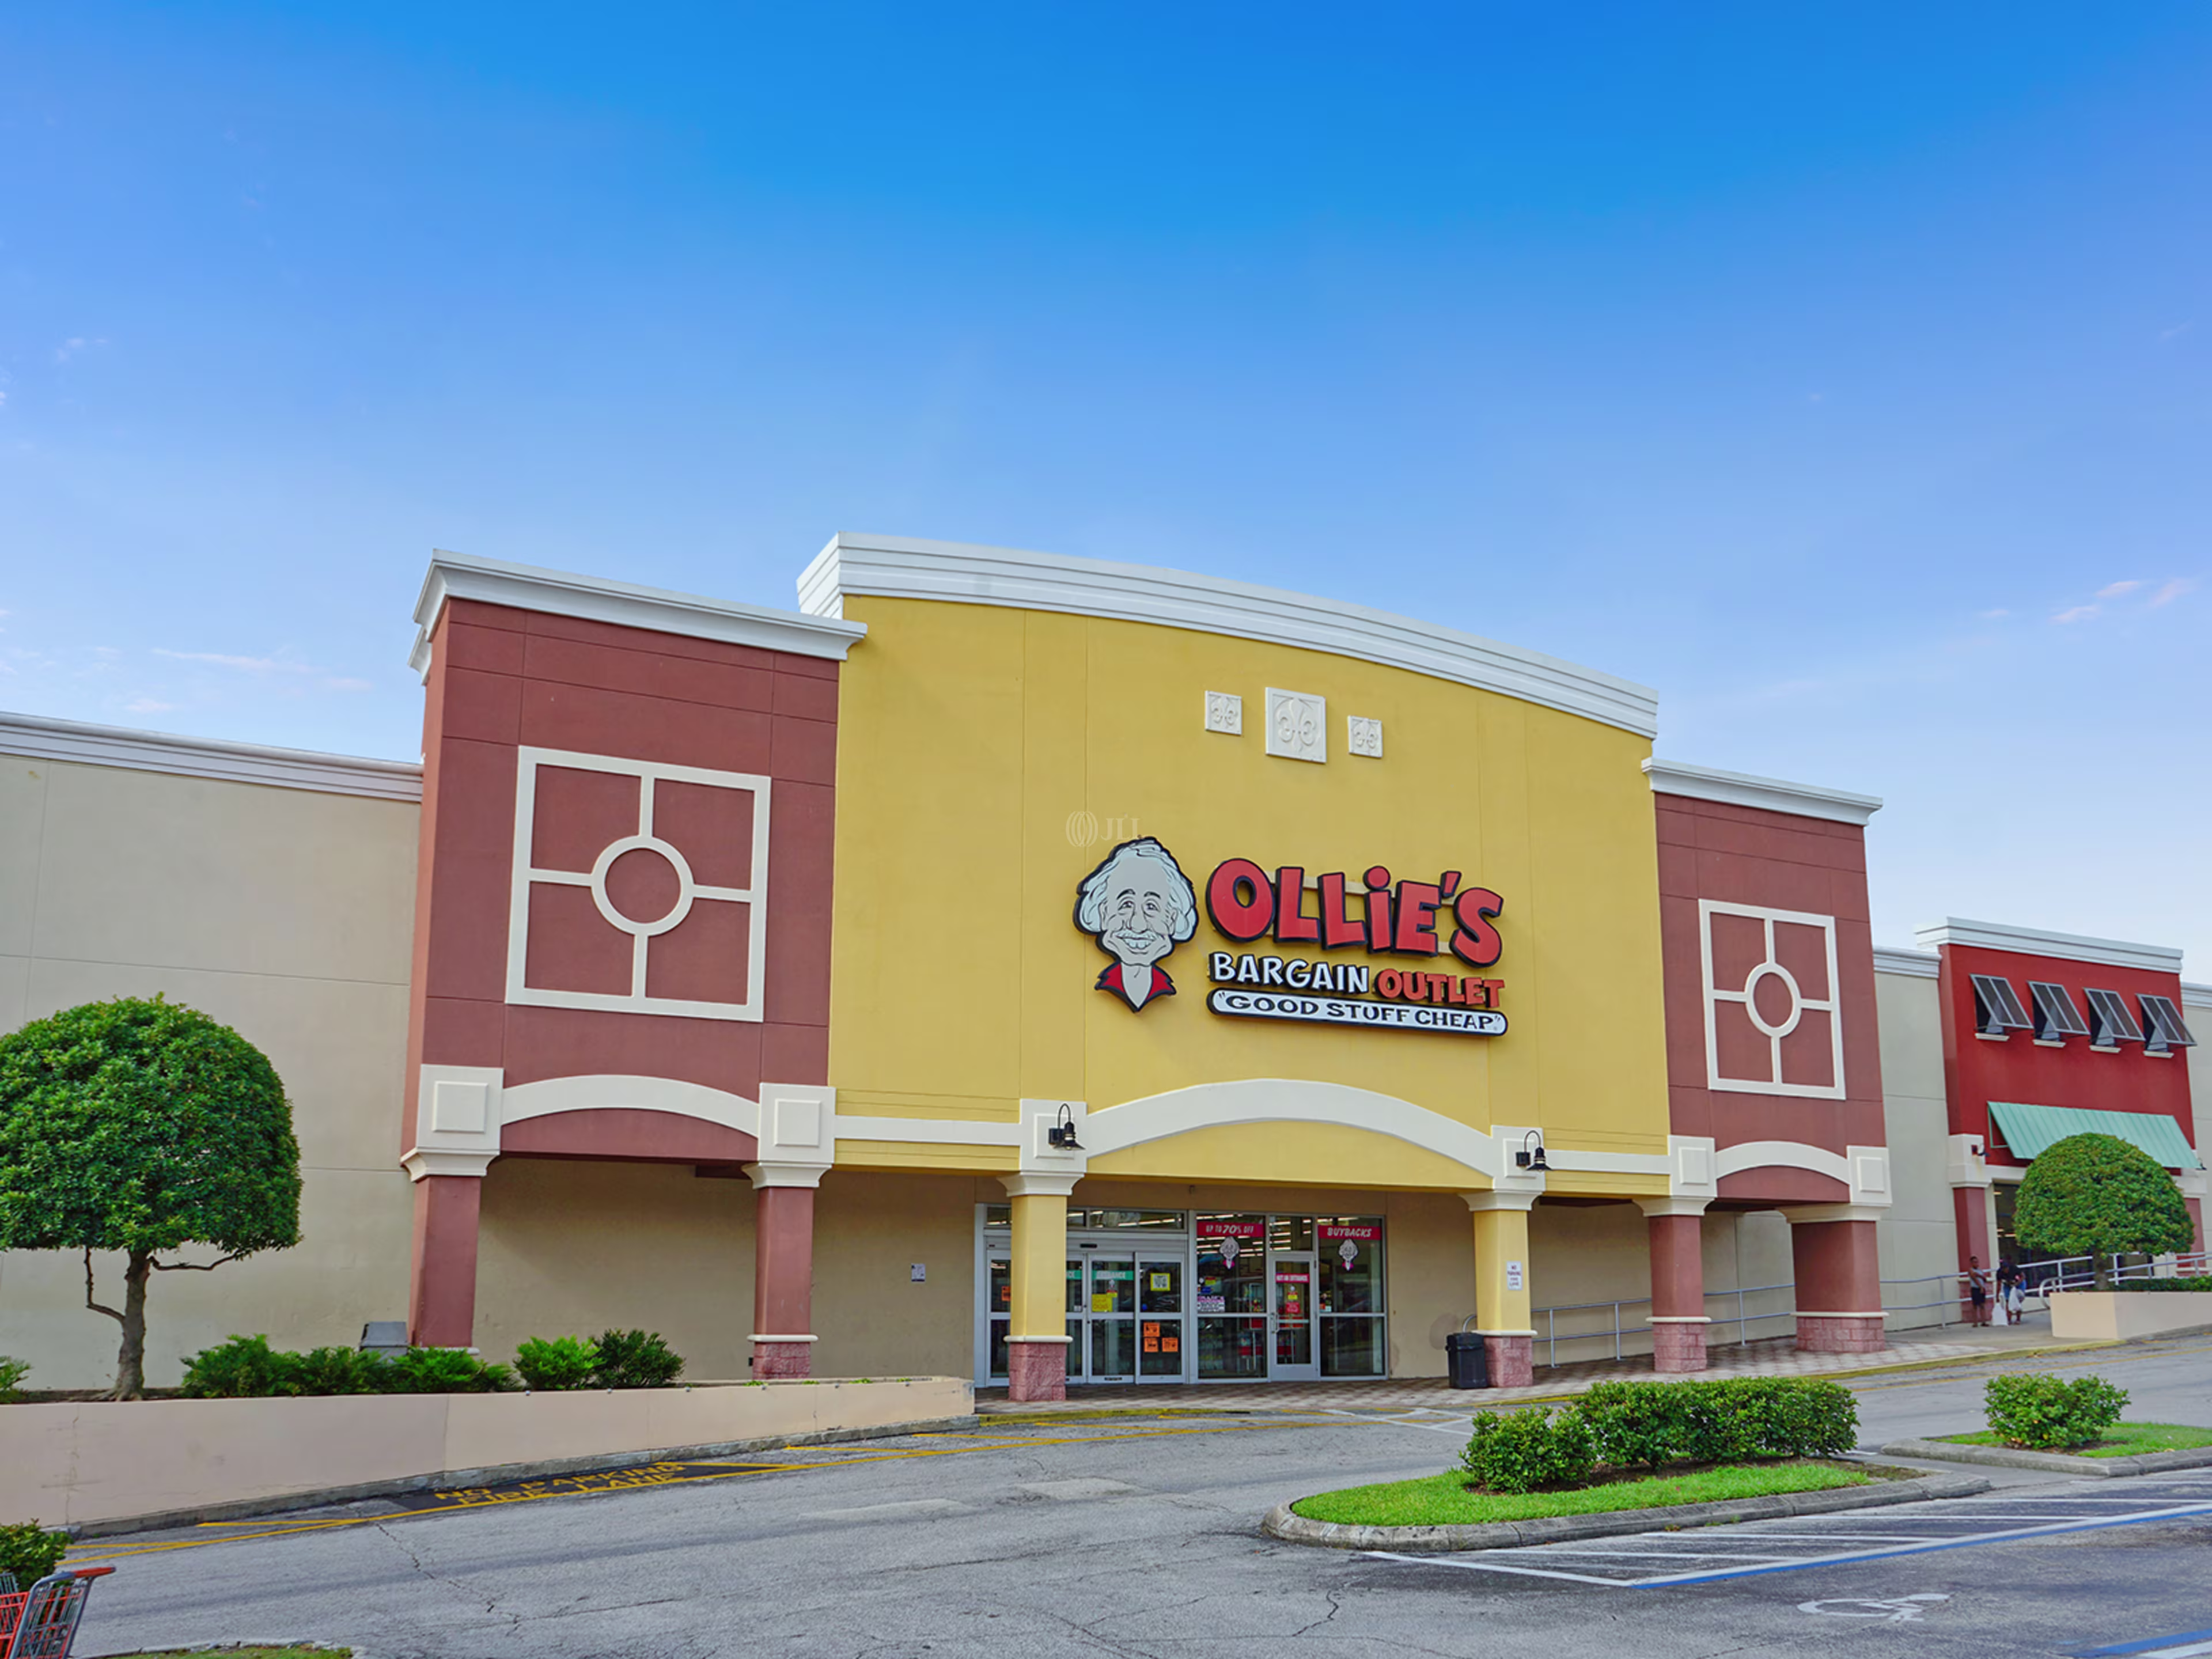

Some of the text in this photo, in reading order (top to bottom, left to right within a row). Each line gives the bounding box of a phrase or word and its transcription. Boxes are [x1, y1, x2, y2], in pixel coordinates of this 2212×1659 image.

[1209, 951, 1505, 1008] BARGAIN OUTLET
[1326, 1002, 1410, 1023] STUFF
[1327, 1227, 1373, 1237] BUYBACKS
[434, 1465, 687, 1500] NO PARKING
[575, 1472, 684, 1491] LANE
